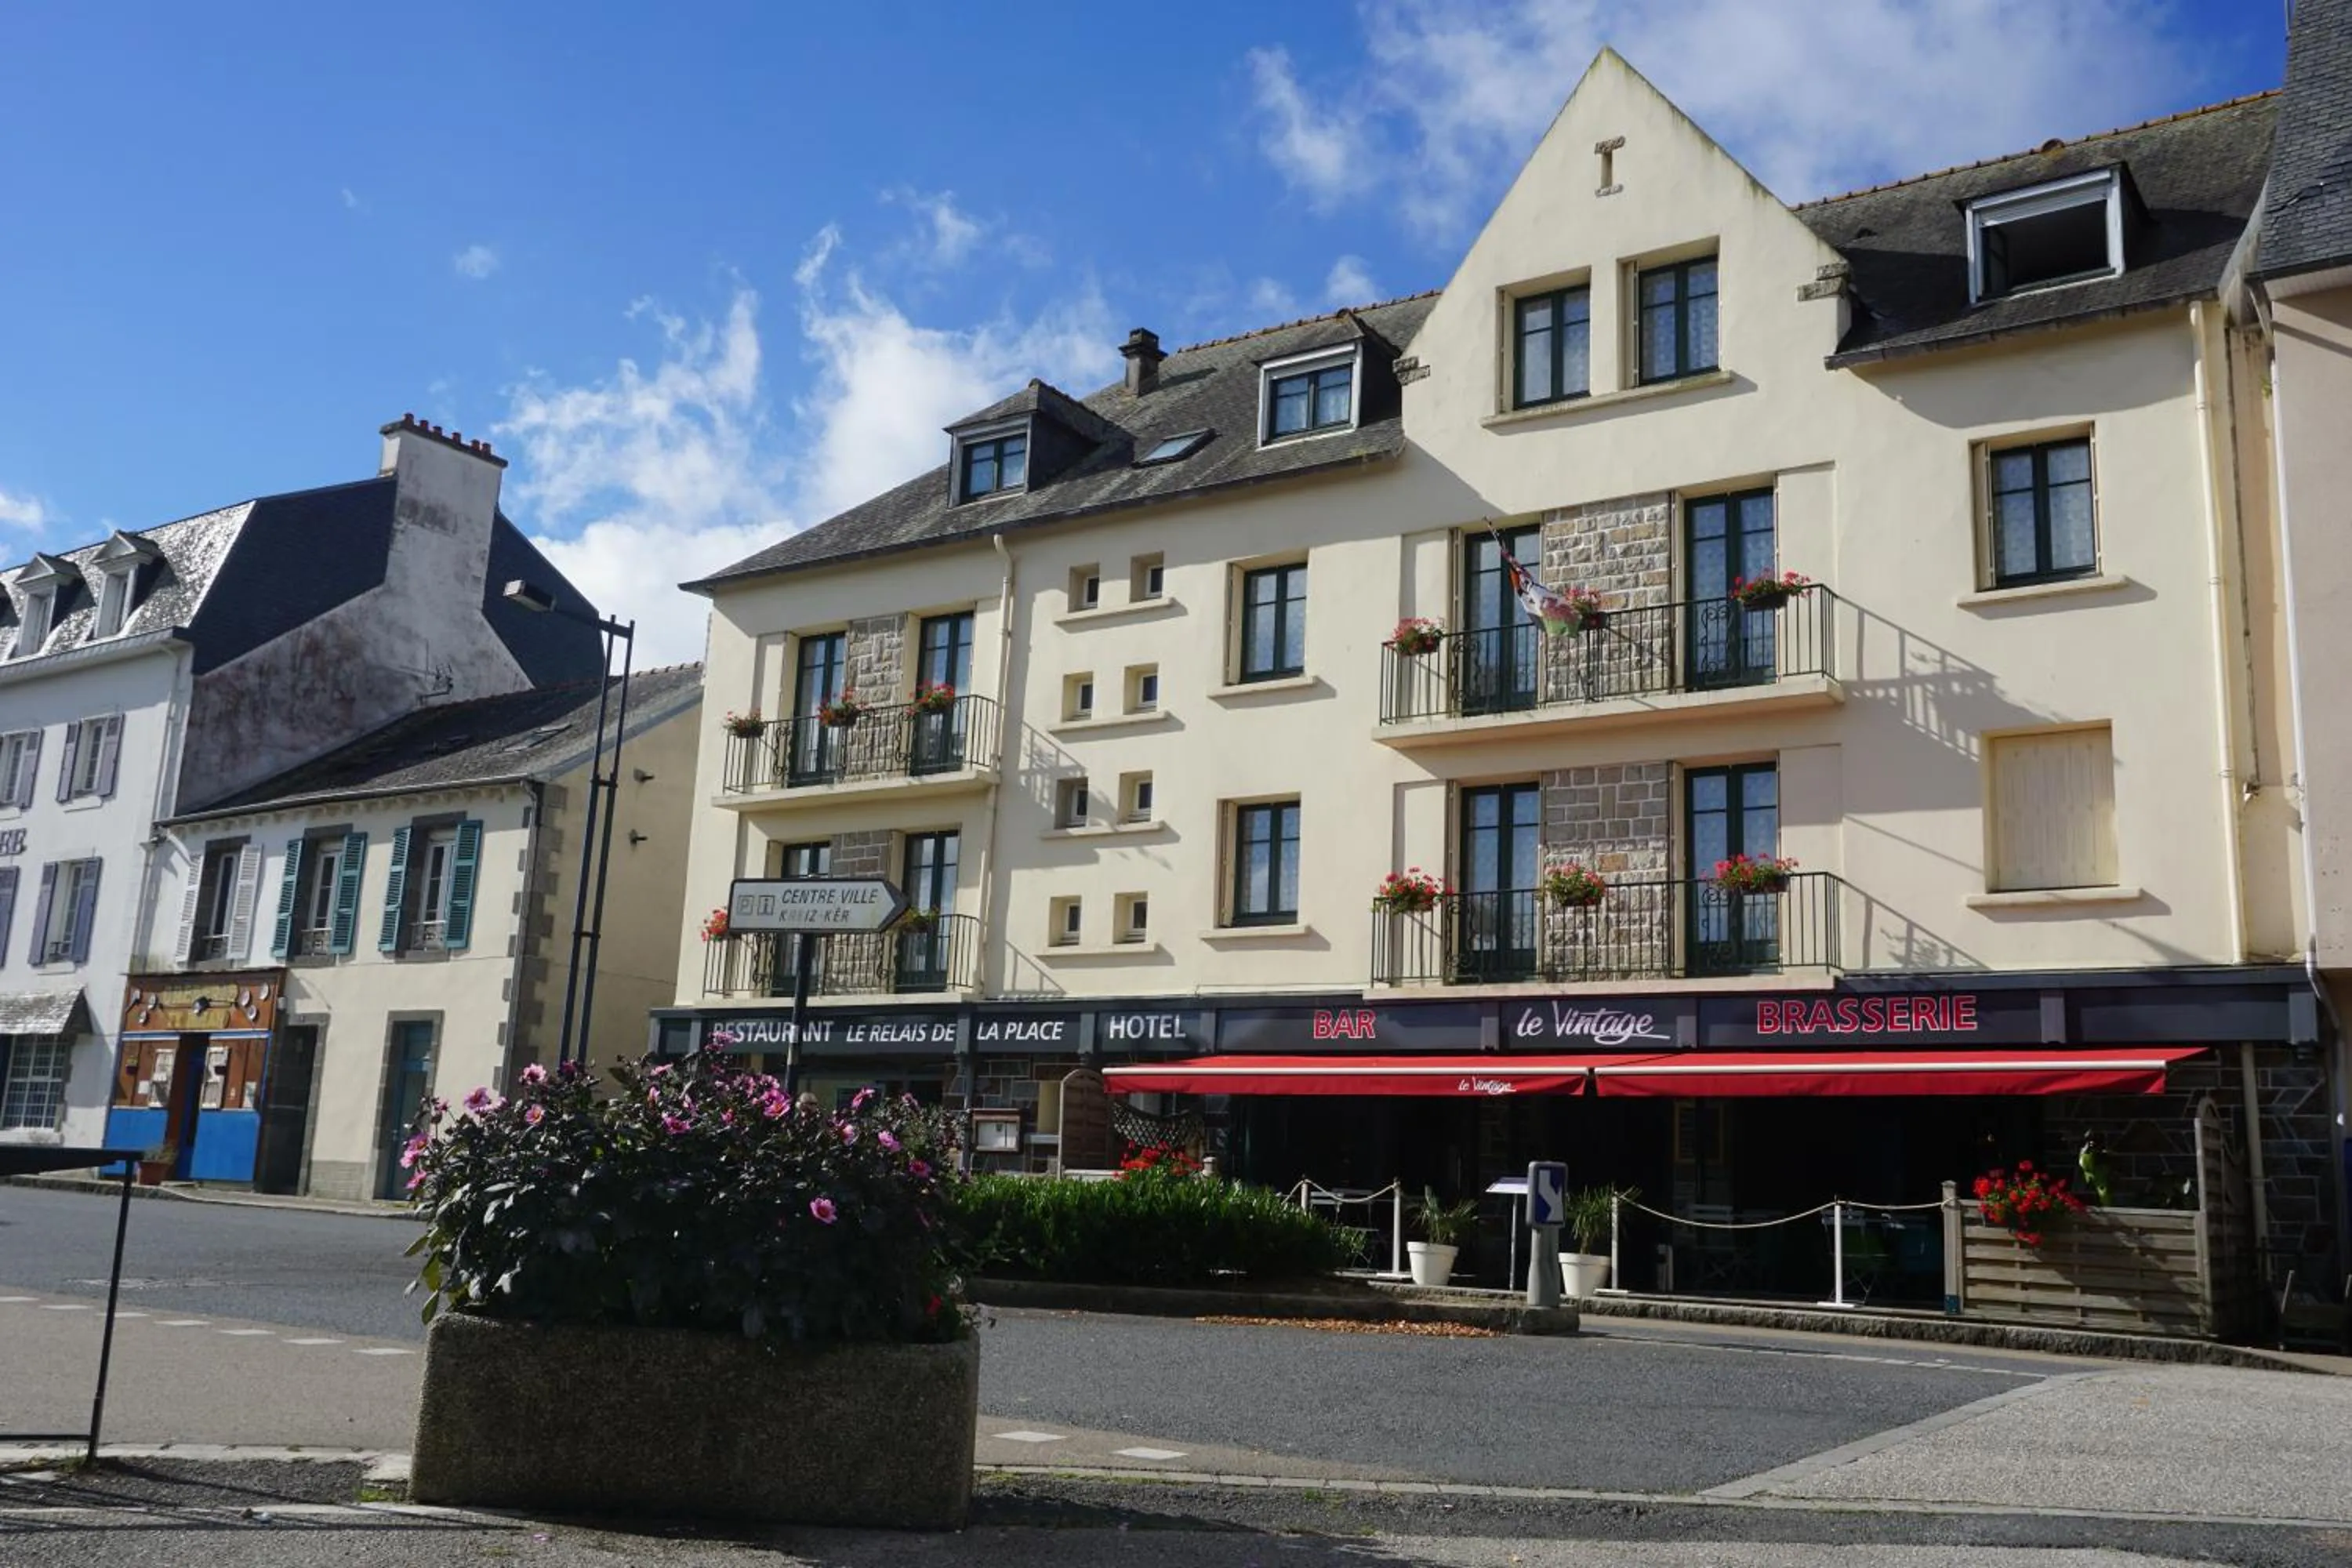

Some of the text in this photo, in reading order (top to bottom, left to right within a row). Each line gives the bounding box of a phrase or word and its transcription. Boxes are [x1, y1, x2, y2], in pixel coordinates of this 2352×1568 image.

[782, 888, 879, 904] CENTRE VILLE
[1109, 1014, 1186, 1040] HOTEL
[1312, 1009, 1377, 1039] BAR
[1552, 1000, 1671, 1045] Vintage
[1756, 995, 1979, 1034] BRASSERIE
[846, 1025, 865, 1042] LE
[869, 1024, 927, 1043] RELAIS
[931, 1022, 957, 1042] DE
[976, 1022, 999, 1040] LA
[1004, 1022, 1065, 1040] PLACE
